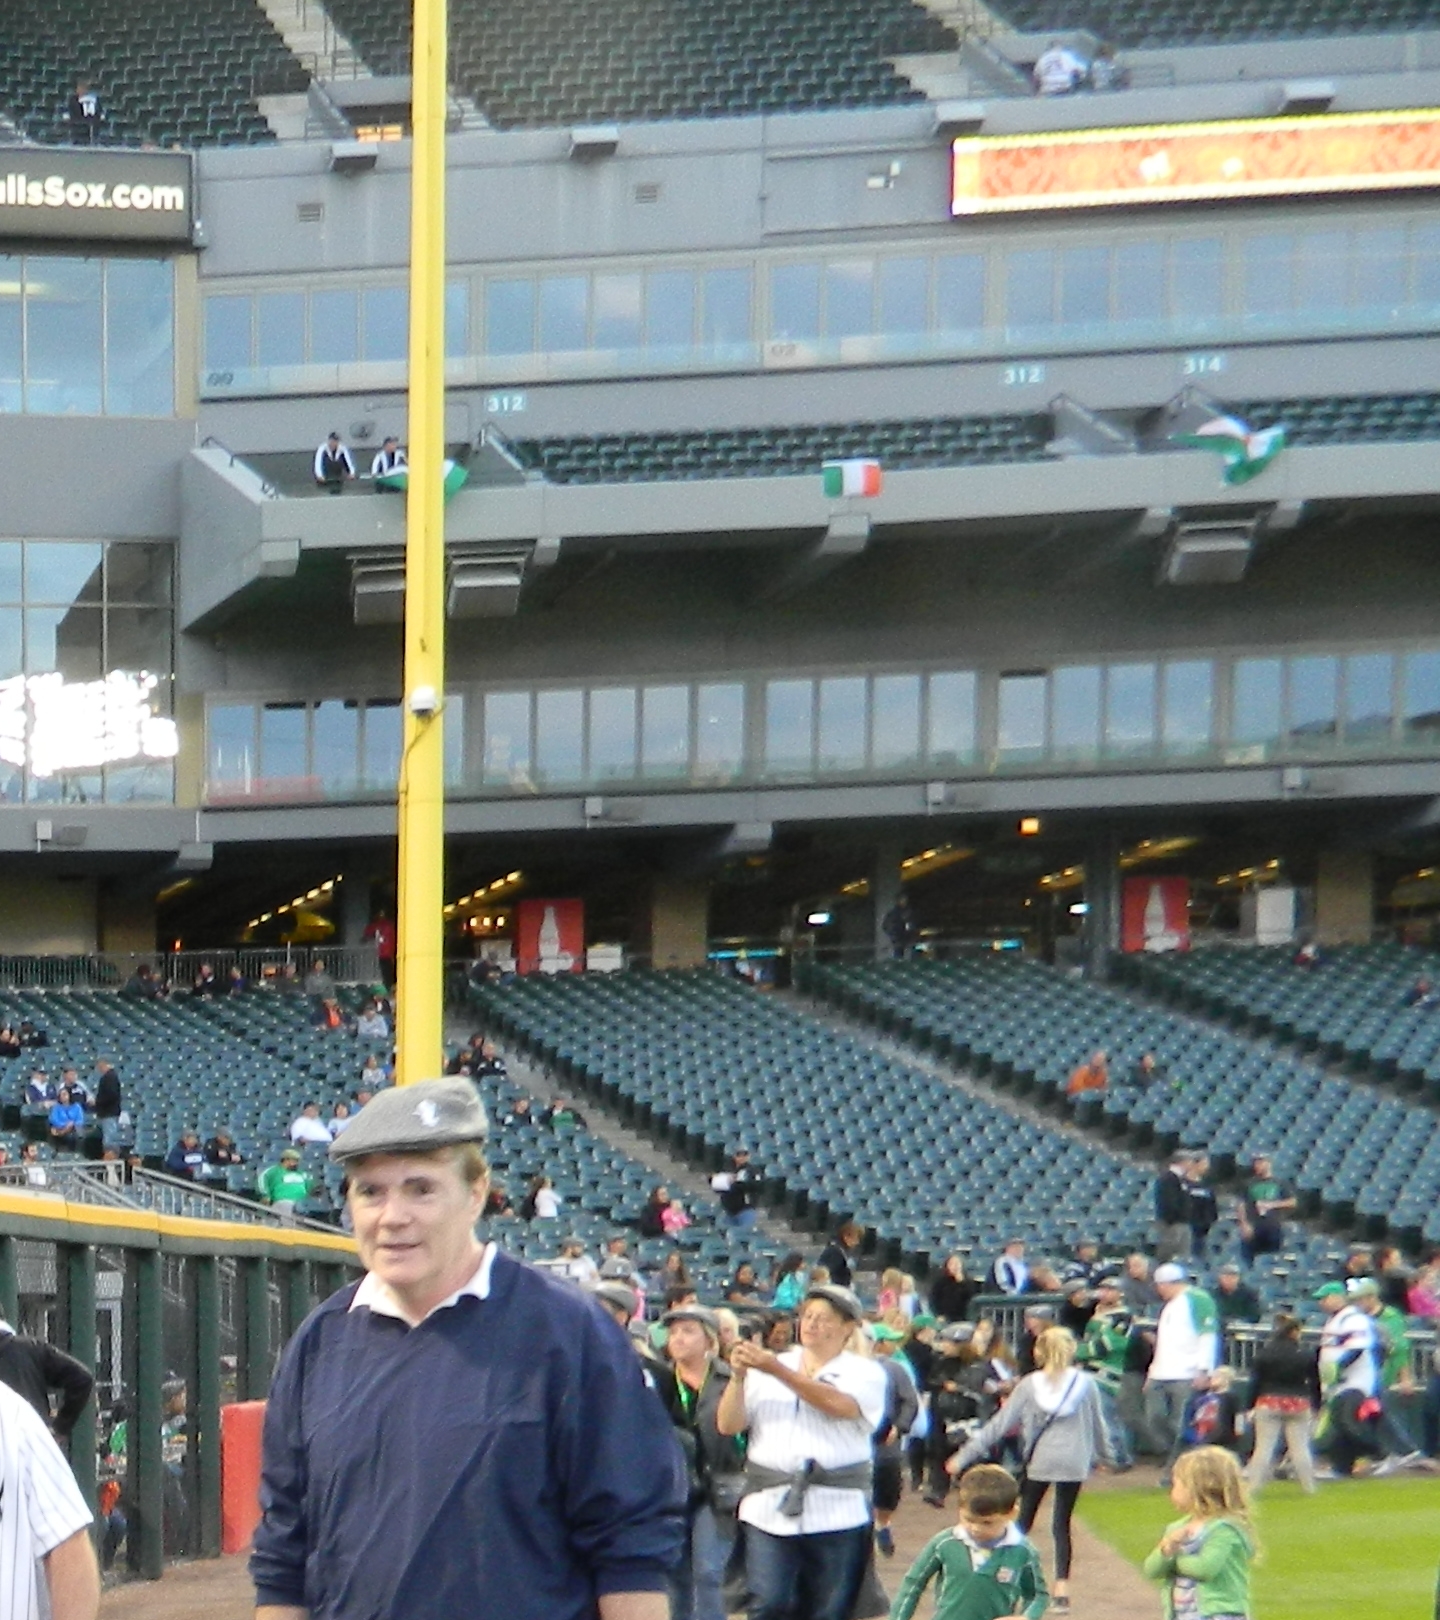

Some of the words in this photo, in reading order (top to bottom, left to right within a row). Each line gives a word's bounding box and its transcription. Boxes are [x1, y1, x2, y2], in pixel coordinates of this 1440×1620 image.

[1182, 355, 1221, 375] 314
[1004, 367, 1044, 385] 312
[487, 394, 524, 413] 312
